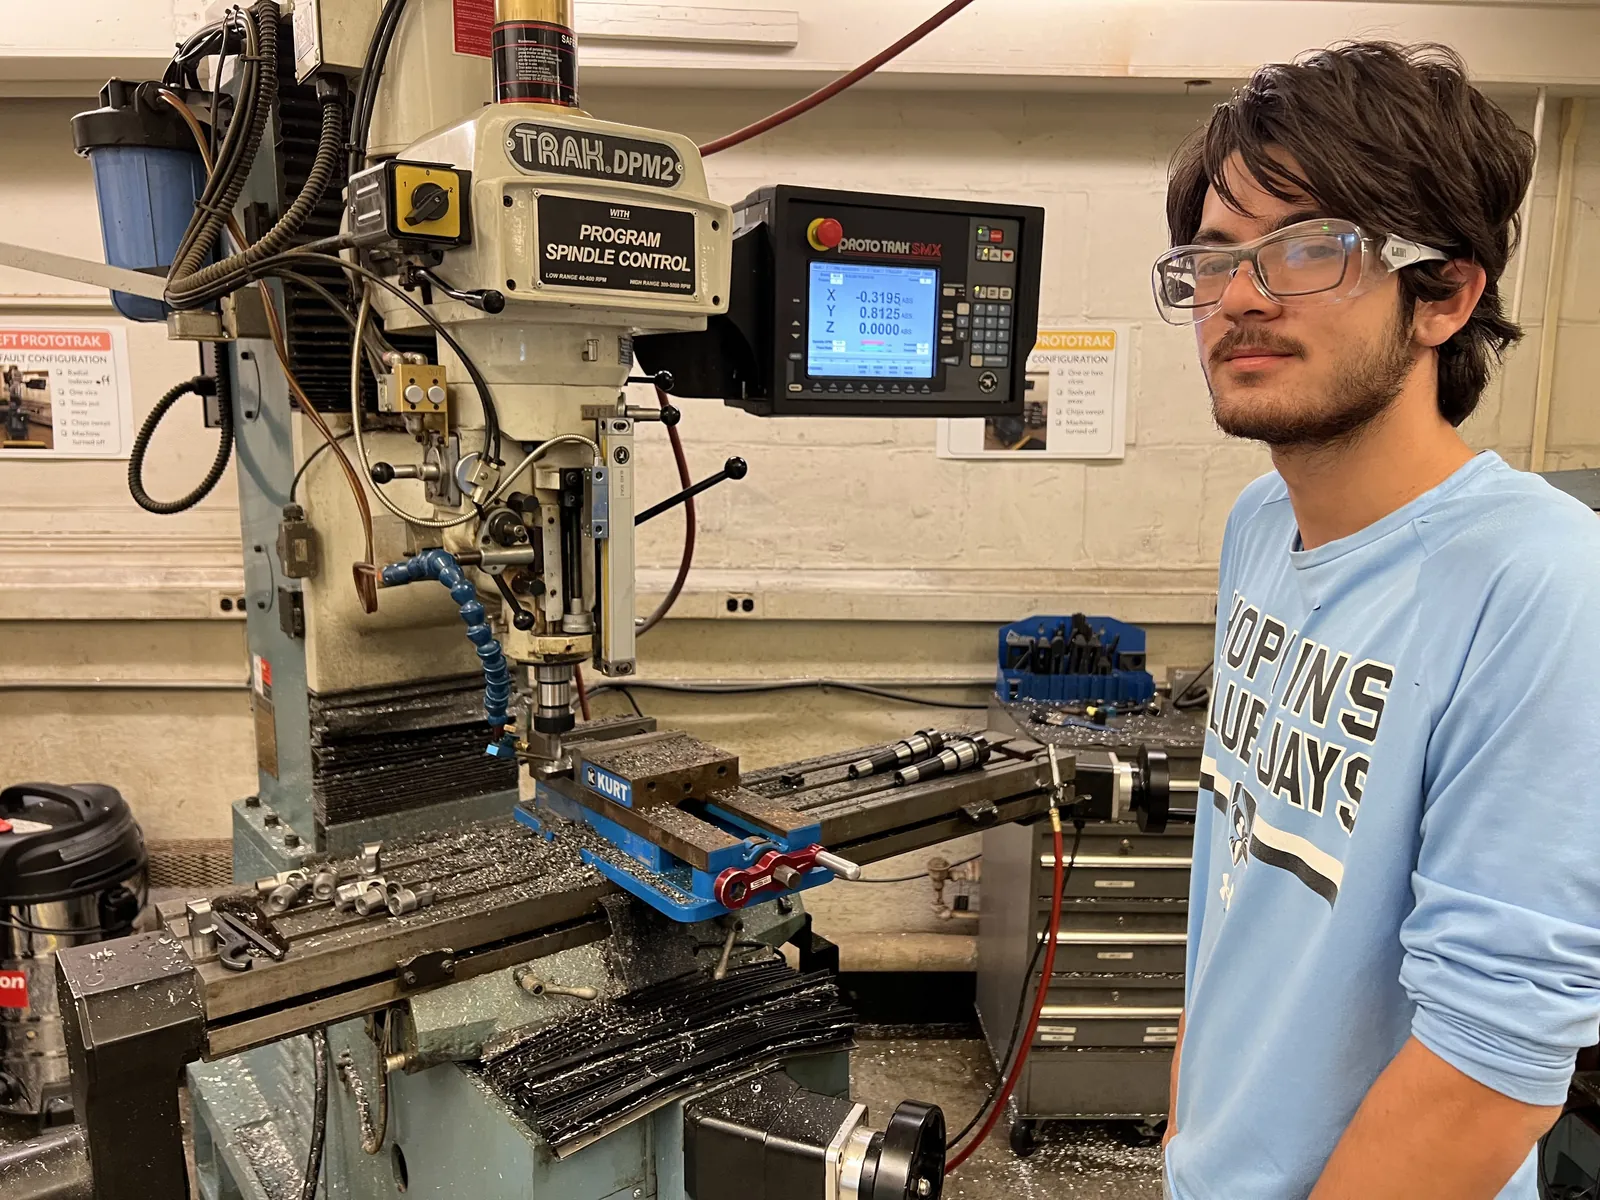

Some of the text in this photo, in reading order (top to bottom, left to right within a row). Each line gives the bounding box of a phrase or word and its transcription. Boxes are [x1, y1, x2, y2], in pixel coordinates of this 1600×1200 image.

[515, 128, 674, 181] TRAK DPM2
[609, 208, 631, 219] WITH
[579, 224, 661, 248] PROGRAM
[911, 242, 941, 256] SMX
[545, 243, 691, 272] SPINDLE CONTROL
[559, 273, 578, 281] RANGE
[826, 288, 836, 301] X
[855, 291, 901, 304] -0.3195
[826, 304, 836, 317] Y
[859, 307, 900, 320] 0.8125
[826, 320, 835, 333] Z
[859, 322, 900, 336] 0.0000
[0, 333, 102, 347] FT PROTOTRAK
[0, 353, 107, 364] AULT CONFIGURATION
[1031, 354, 1108, 364] CONFIGURATION
[1221, 589, 1395, 745] OPINS
[1209, 668, 1371, 838] LUE JAYS
[597, 771, 628, 802] KURT
